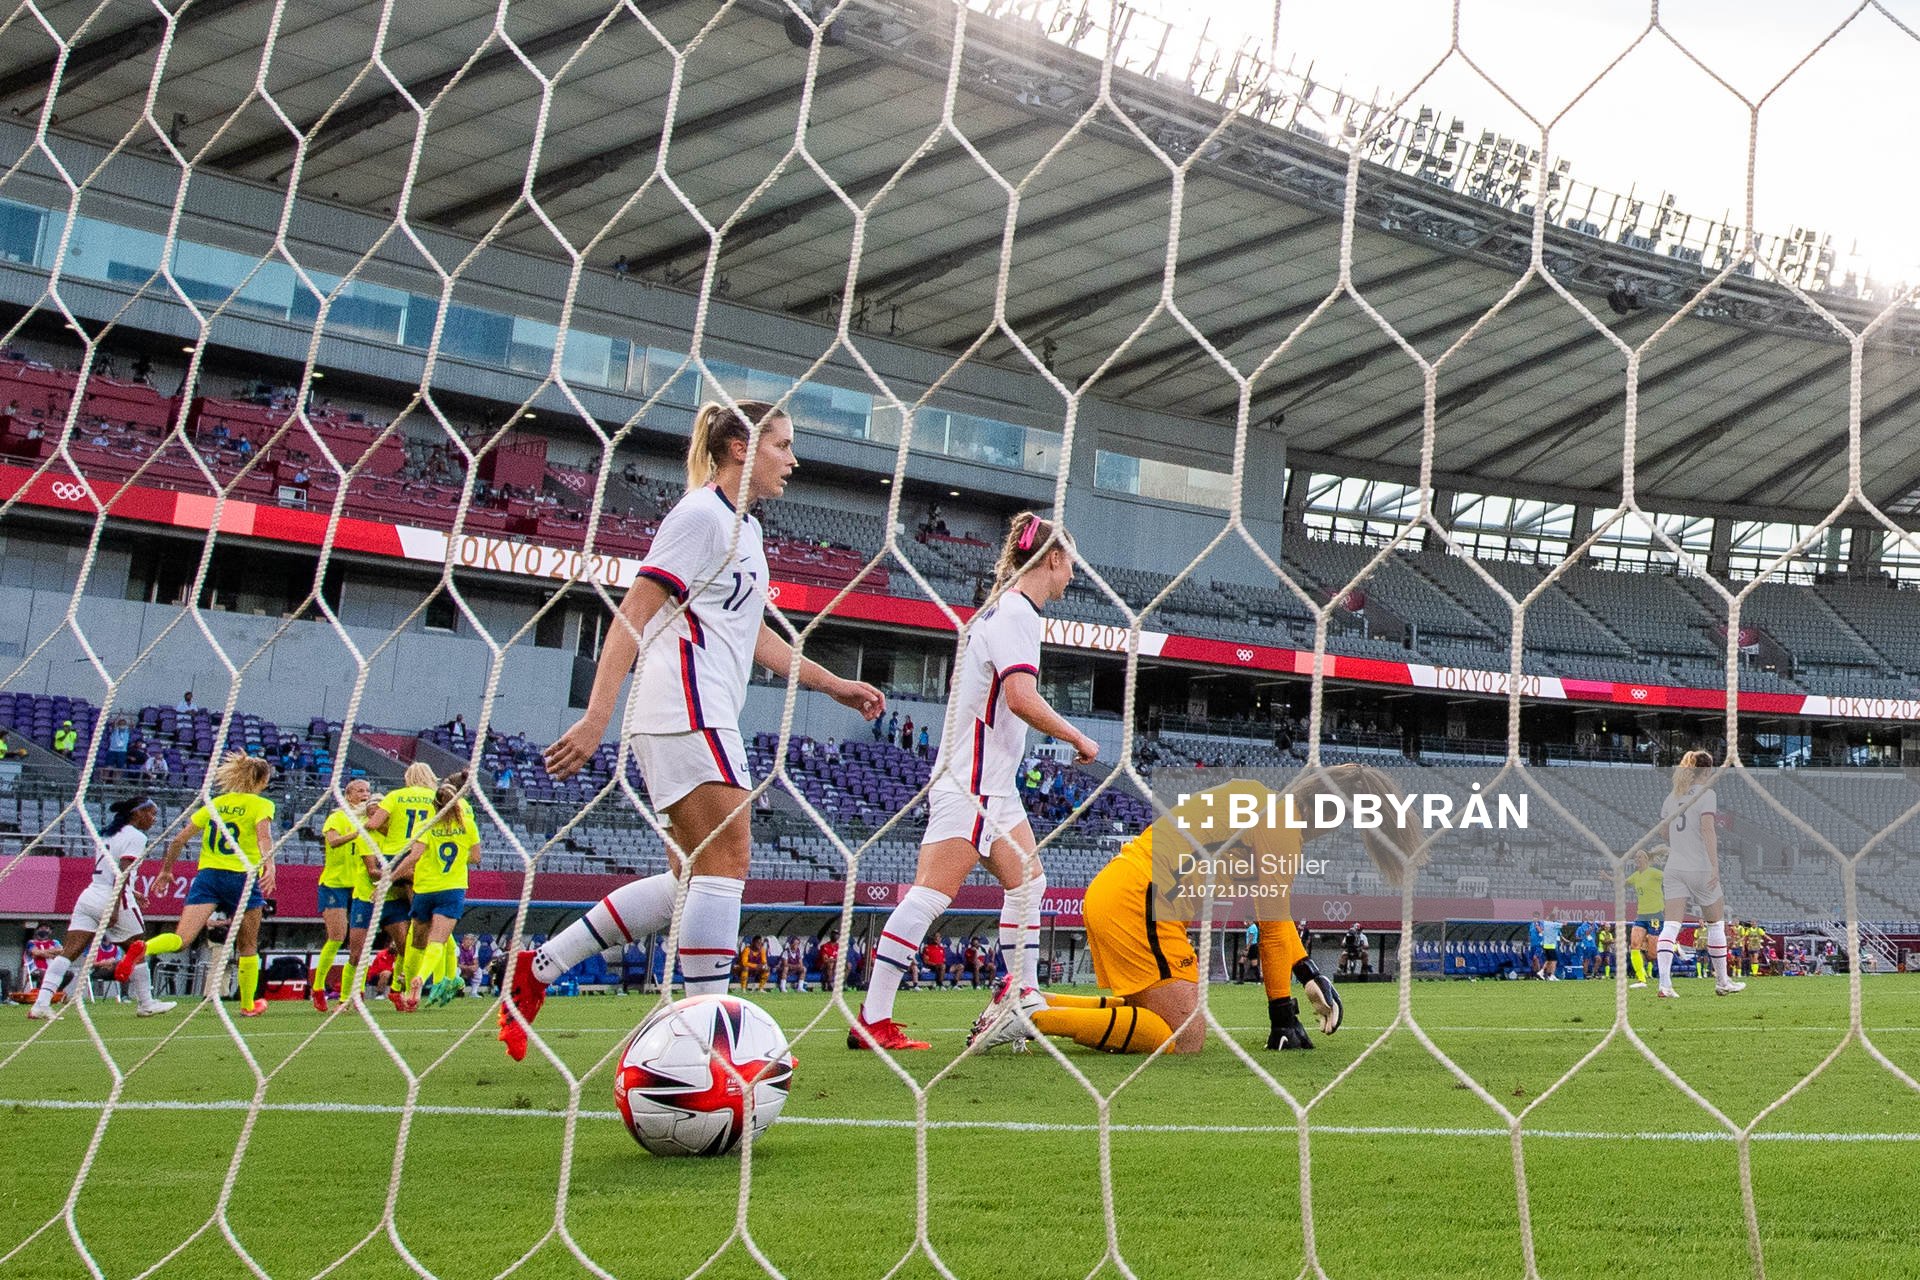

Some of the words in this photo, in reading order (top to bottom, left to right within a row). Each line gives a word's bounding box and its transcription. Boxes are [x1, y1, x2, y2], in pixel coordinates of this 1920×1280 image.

[550, 550, 621, 586] 2020
[722, 571, 757, 612] 17
[1045, 617, 1085, 647] KYO
[1090, 624, 1136, 654] 202
[1434, 665, 1493, 693] TOKYO
[1498, 672, 1541, 697] 220
[1826, 695, 1885, 719] TOKYO
[438, 841, 459, 873] 9
